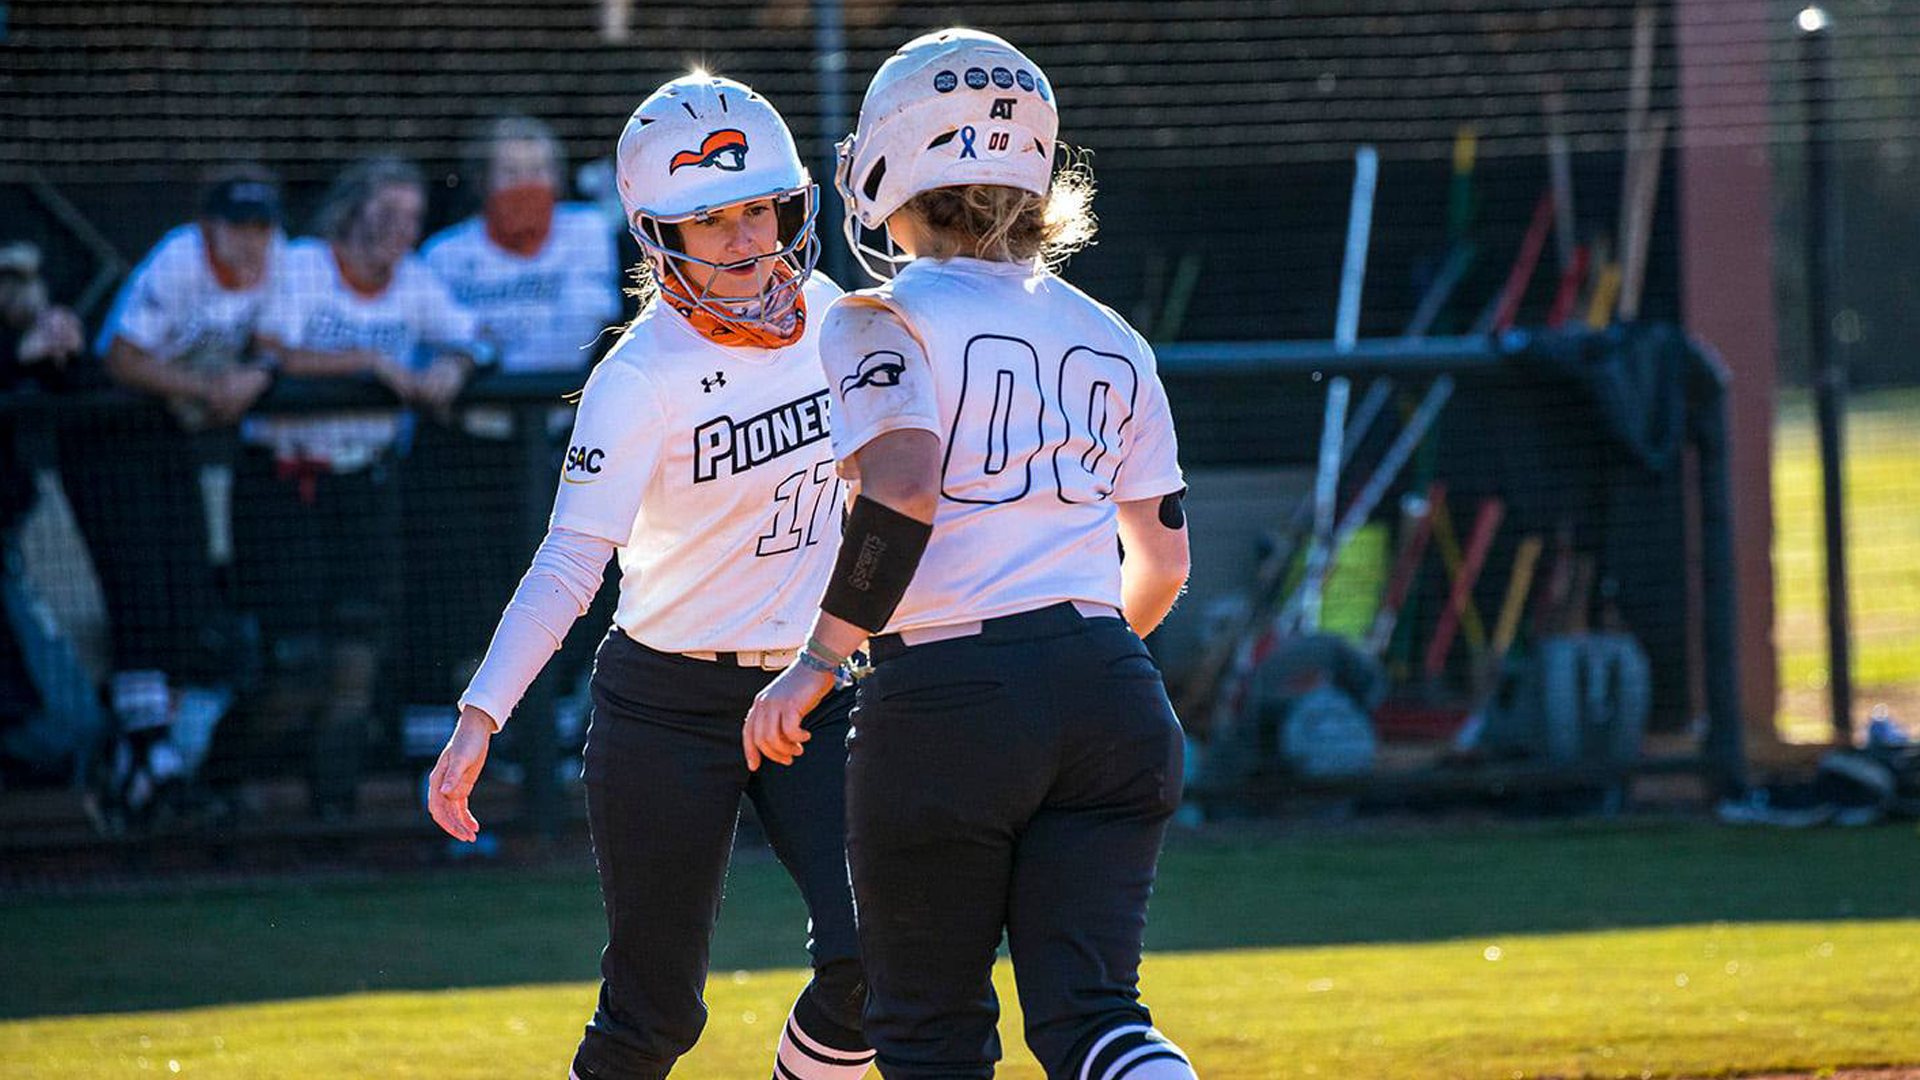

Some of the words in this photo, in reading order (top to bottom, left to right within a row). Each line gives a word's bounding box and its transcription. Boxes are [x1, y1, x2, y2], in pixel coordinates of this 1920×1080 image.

[989, 98, 1017, 119] AT
[989, 133, 1009, 150] 00
[941, 333, 1138, 504] 00
[566, 446, 606, 474] SAC
